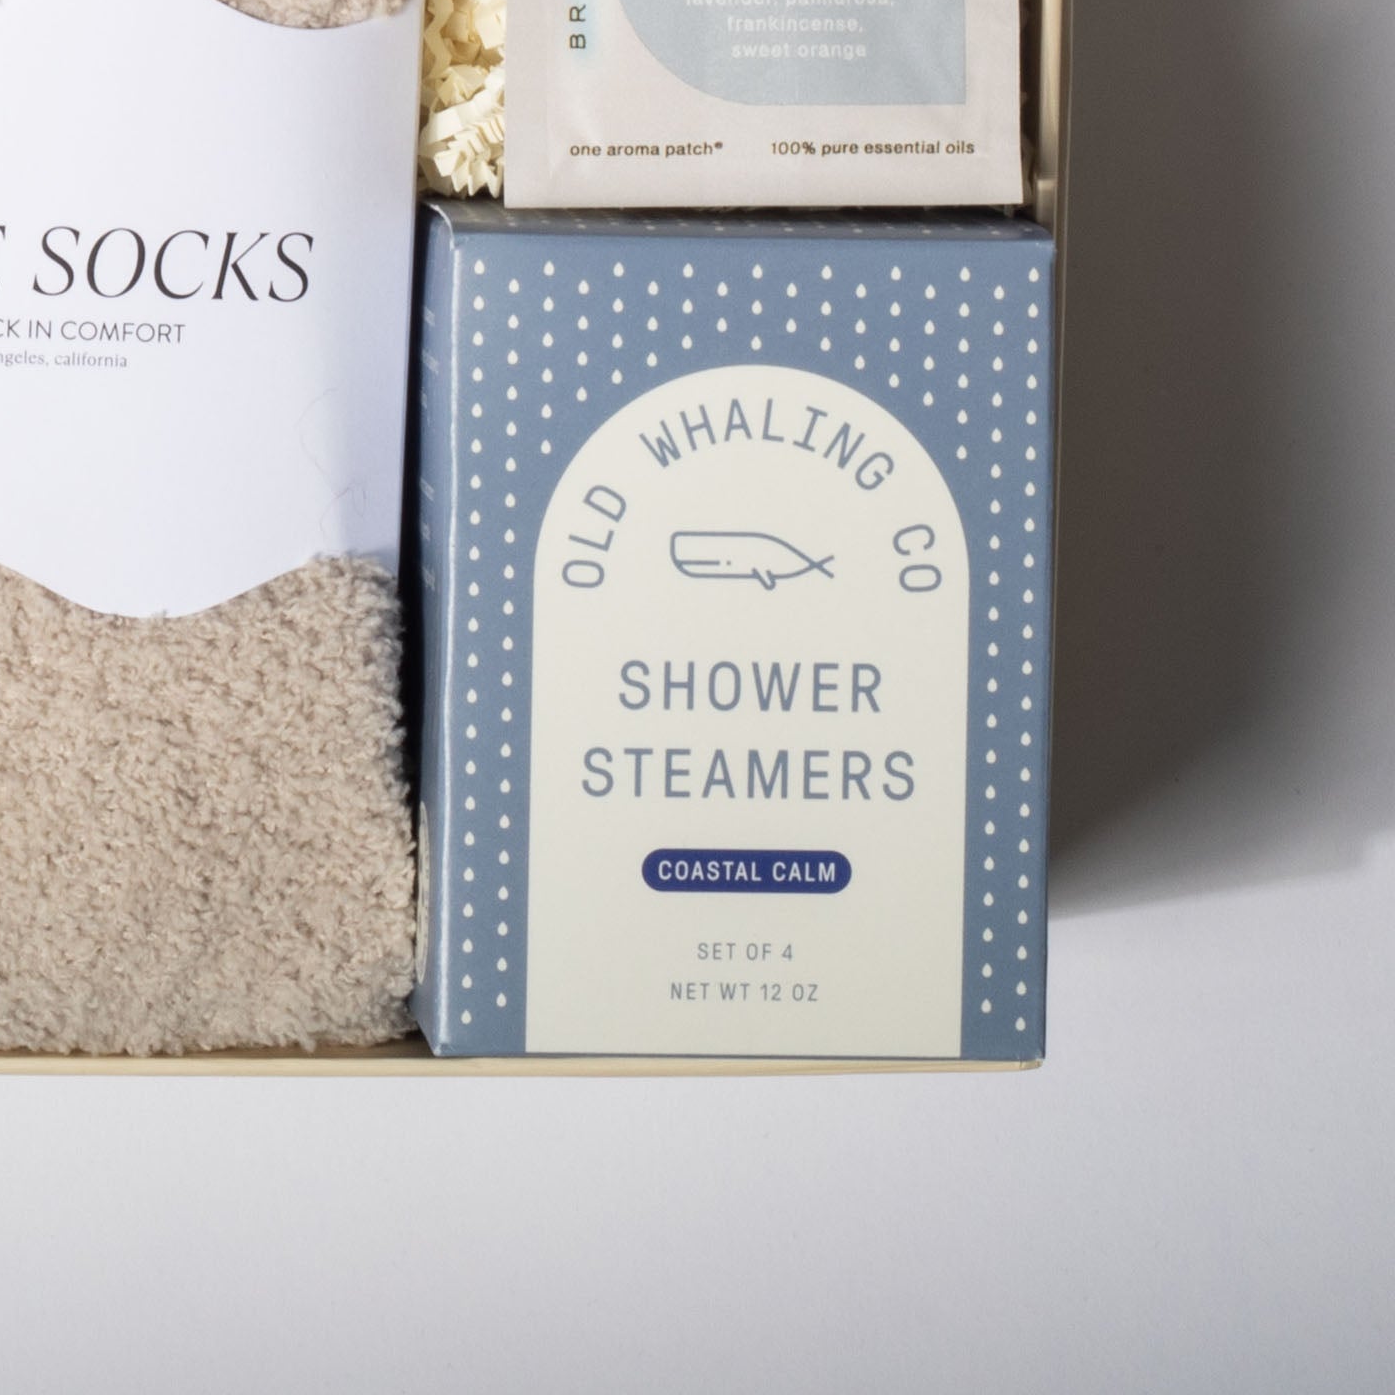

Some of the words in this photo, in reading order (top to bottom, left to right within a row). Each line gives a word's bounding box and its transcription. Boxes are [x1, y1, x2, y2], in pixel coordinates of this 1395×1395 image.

[727, 15, 864, 34] frankincense,
[731, 43, 793, 59] sweet
[797, 44, 868, 61] orange
[570, 145, 602, 157] one
[607, 145, 661, 157] aroma
[770, 141, 816, 155] 100%
[821, 143, 859, 157] pure
[864, 141, 940, 155] essential
[945, 140, 976, 155] oils
[32, 225, 314, 303] SOCKS
[27, 320, 52, 340] IN
[61, 320, 186, 344] COMFORT
[54, 351, 128, 368] california
[561, 483, 628, 589] OLD
[638, 397, 896, 492] WHALING
[892, 522, 943, 593] CO
[618, 659, 883, 714] SHOWER
[581, 746, 916, 801] STEAMERS
[657, 860, 762, 882] COASTAL
[771, 861, 837, 883] CALM
[697, 943, 737, 961] SET
[745, 943, 772, 961] OF
[782, 944, 794, 961] 4
[670, 982, 710, 1001] NET
[719, 983, 751, 1001] WT
[760, 984, 783, 1002] 12
[791, 985, 819, 1002] OZ
